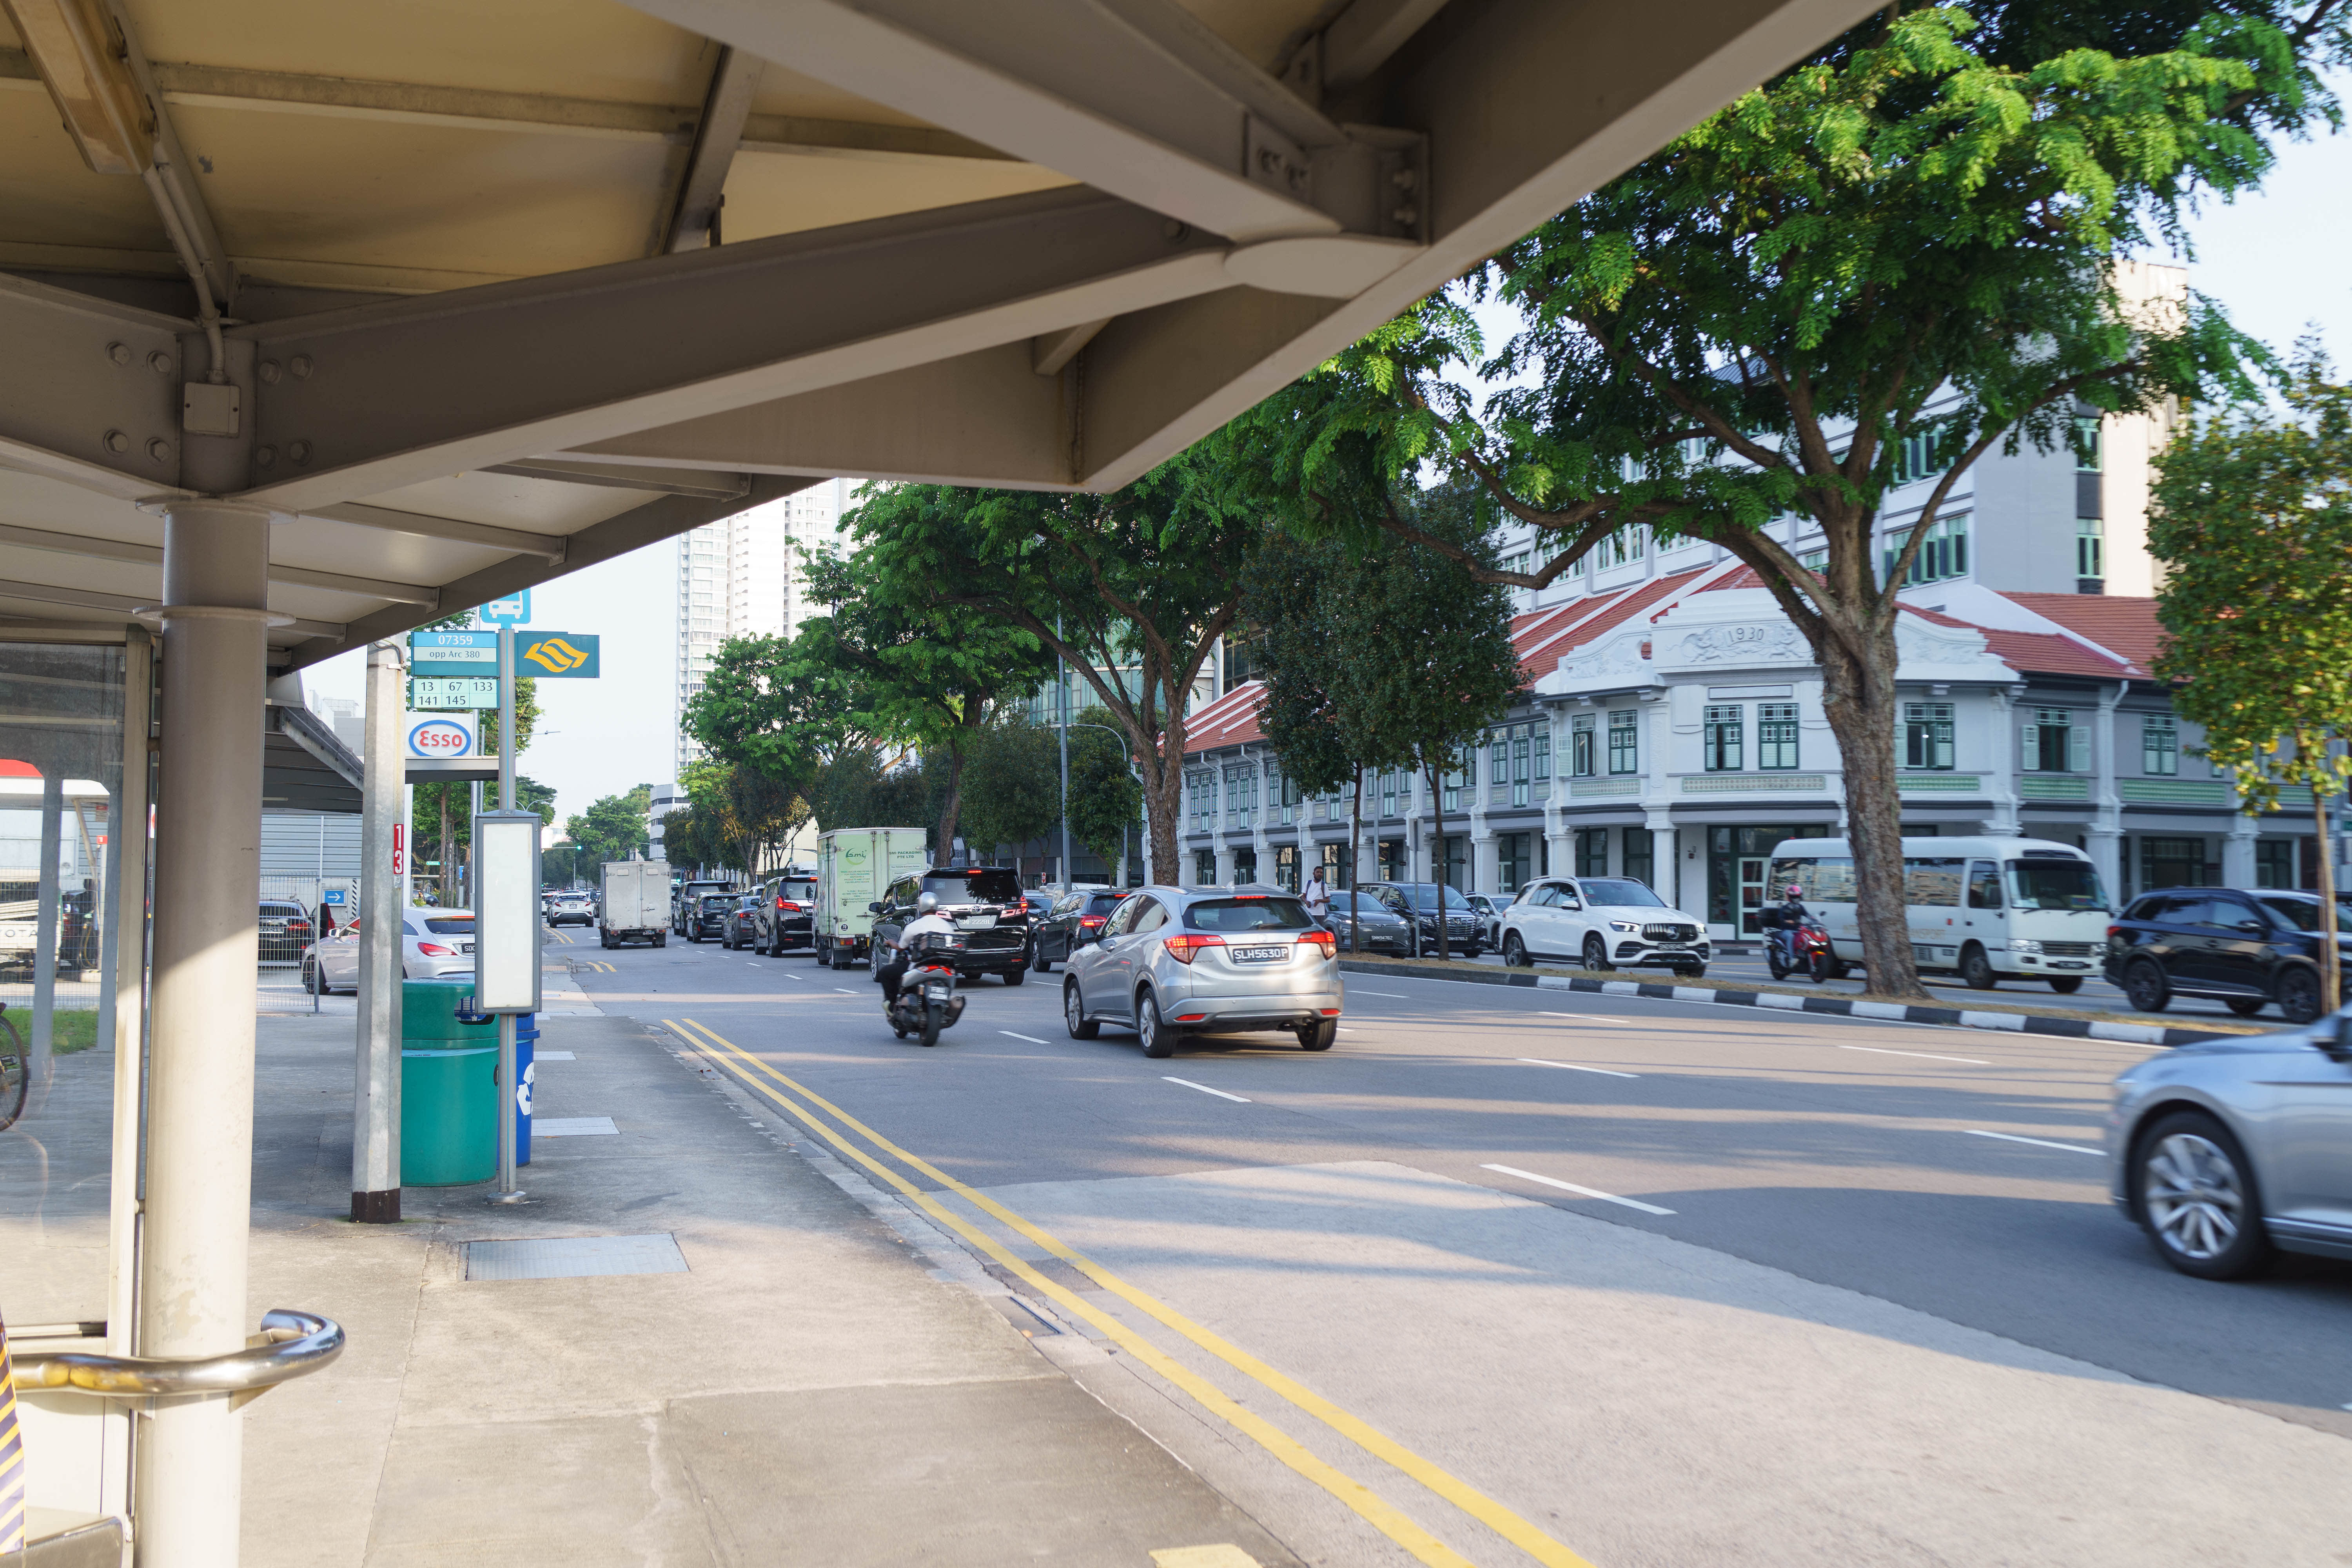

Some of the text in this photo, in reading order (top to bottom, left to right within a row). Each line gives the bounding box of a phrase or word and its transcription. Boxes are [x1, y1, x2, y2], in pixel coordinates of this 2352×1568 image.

[438, 635, 473, 645] 07359
[1728, 627, 1764, 642] 1930
[421, 682, 492, 691] 13 67 133
[418, 696, 466, 705] 141 145
[419, 730, 463, 747] Esso
[1234, 948, 1288, 960] SLH5630P
